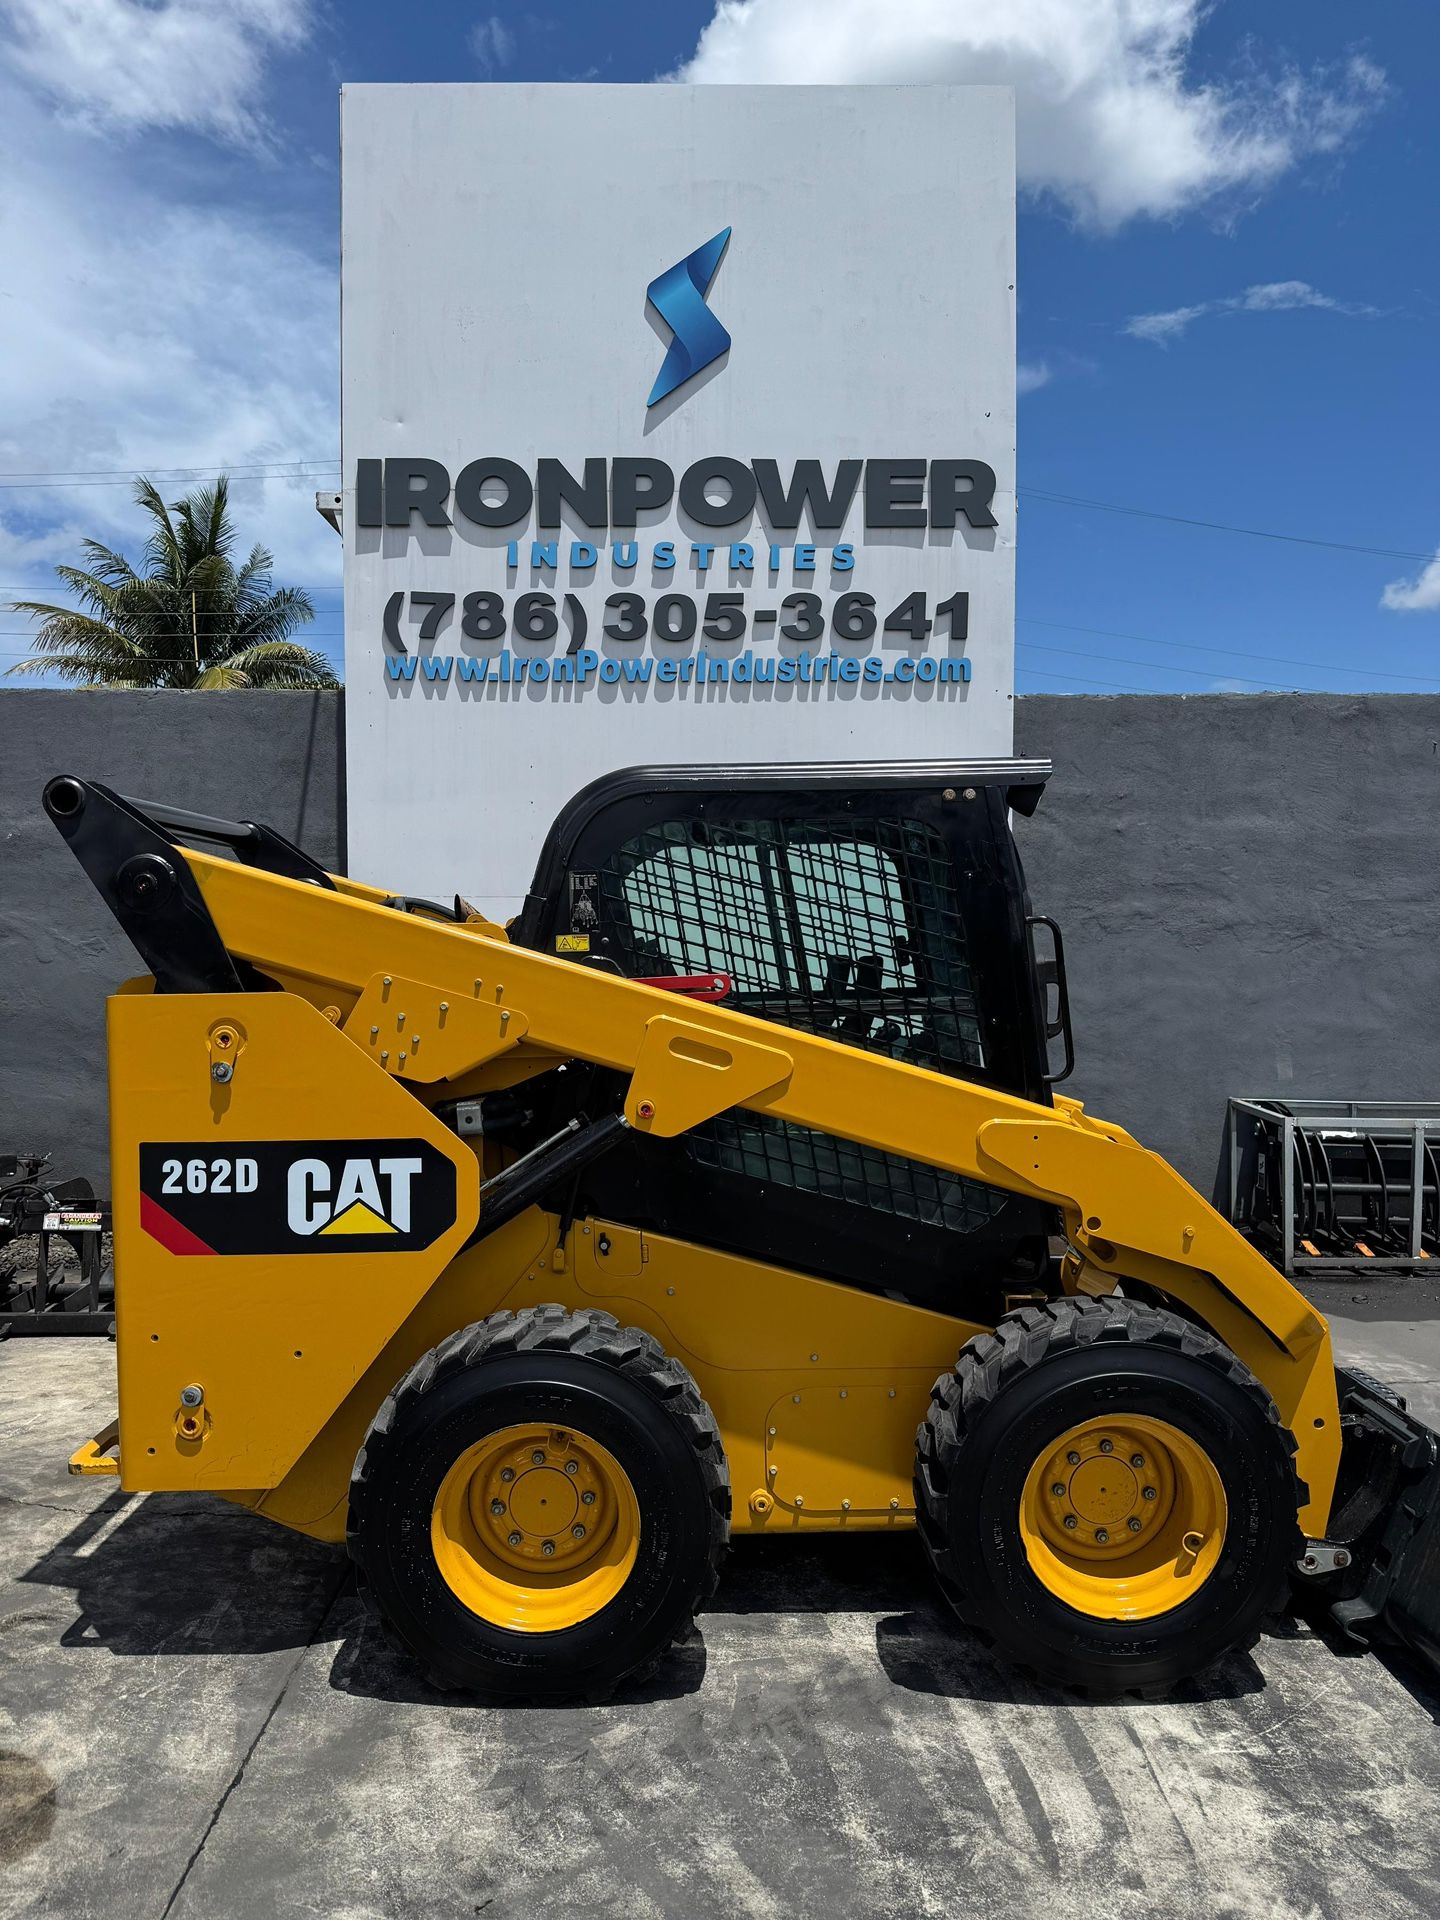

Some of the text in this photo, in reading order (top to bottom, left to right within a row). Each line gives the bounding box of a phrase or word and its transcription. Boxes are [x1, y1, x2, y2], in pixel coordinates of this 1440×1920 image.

[356, 457, 999, 529] IRONPOWER
[507, 542, 856, 571] INDUSTRIES
[386, 648, 972, 684] www.IronPowerIndustries.com
[161, 1157, 423, 1236] 262D CAT
